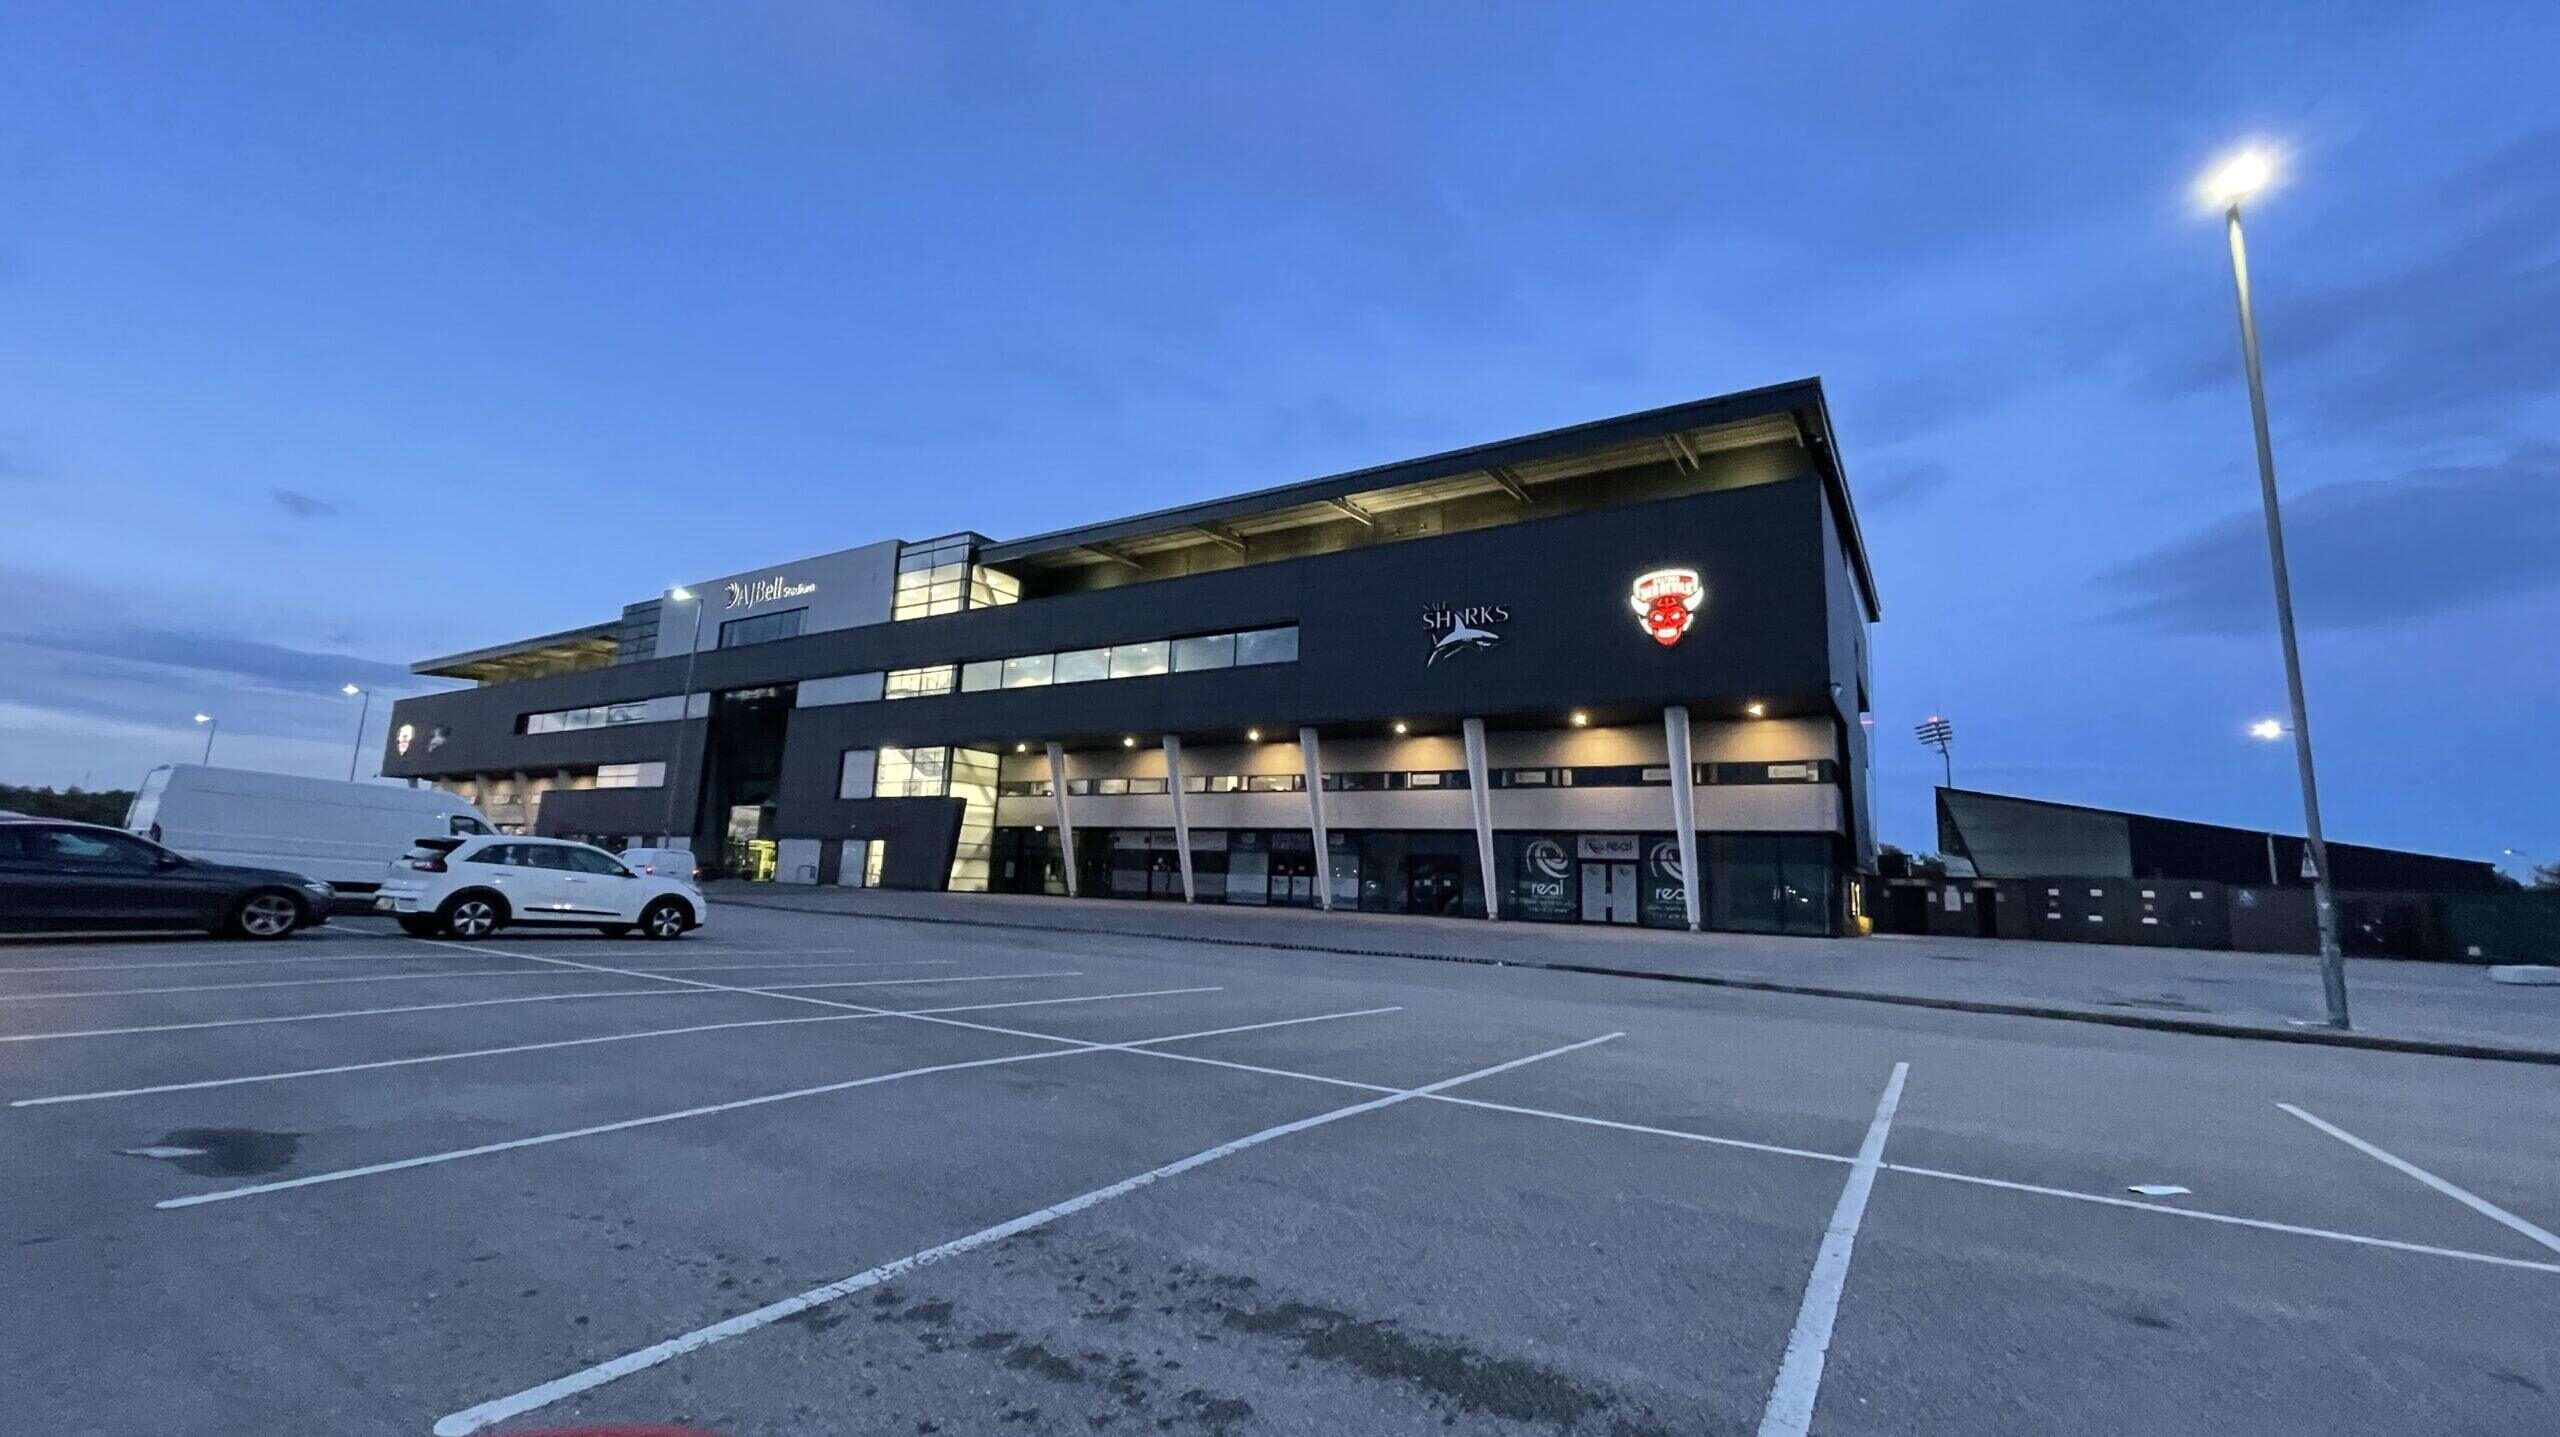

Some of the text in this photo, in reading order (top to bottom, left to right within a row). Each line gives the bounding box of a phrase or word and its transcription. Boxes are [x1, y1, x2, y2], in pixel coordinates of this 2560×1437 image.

[756, 576, 783, 602] Bell
[1531, 879, 1564, 896] real
[1655, 888, 1685, 901] rea
